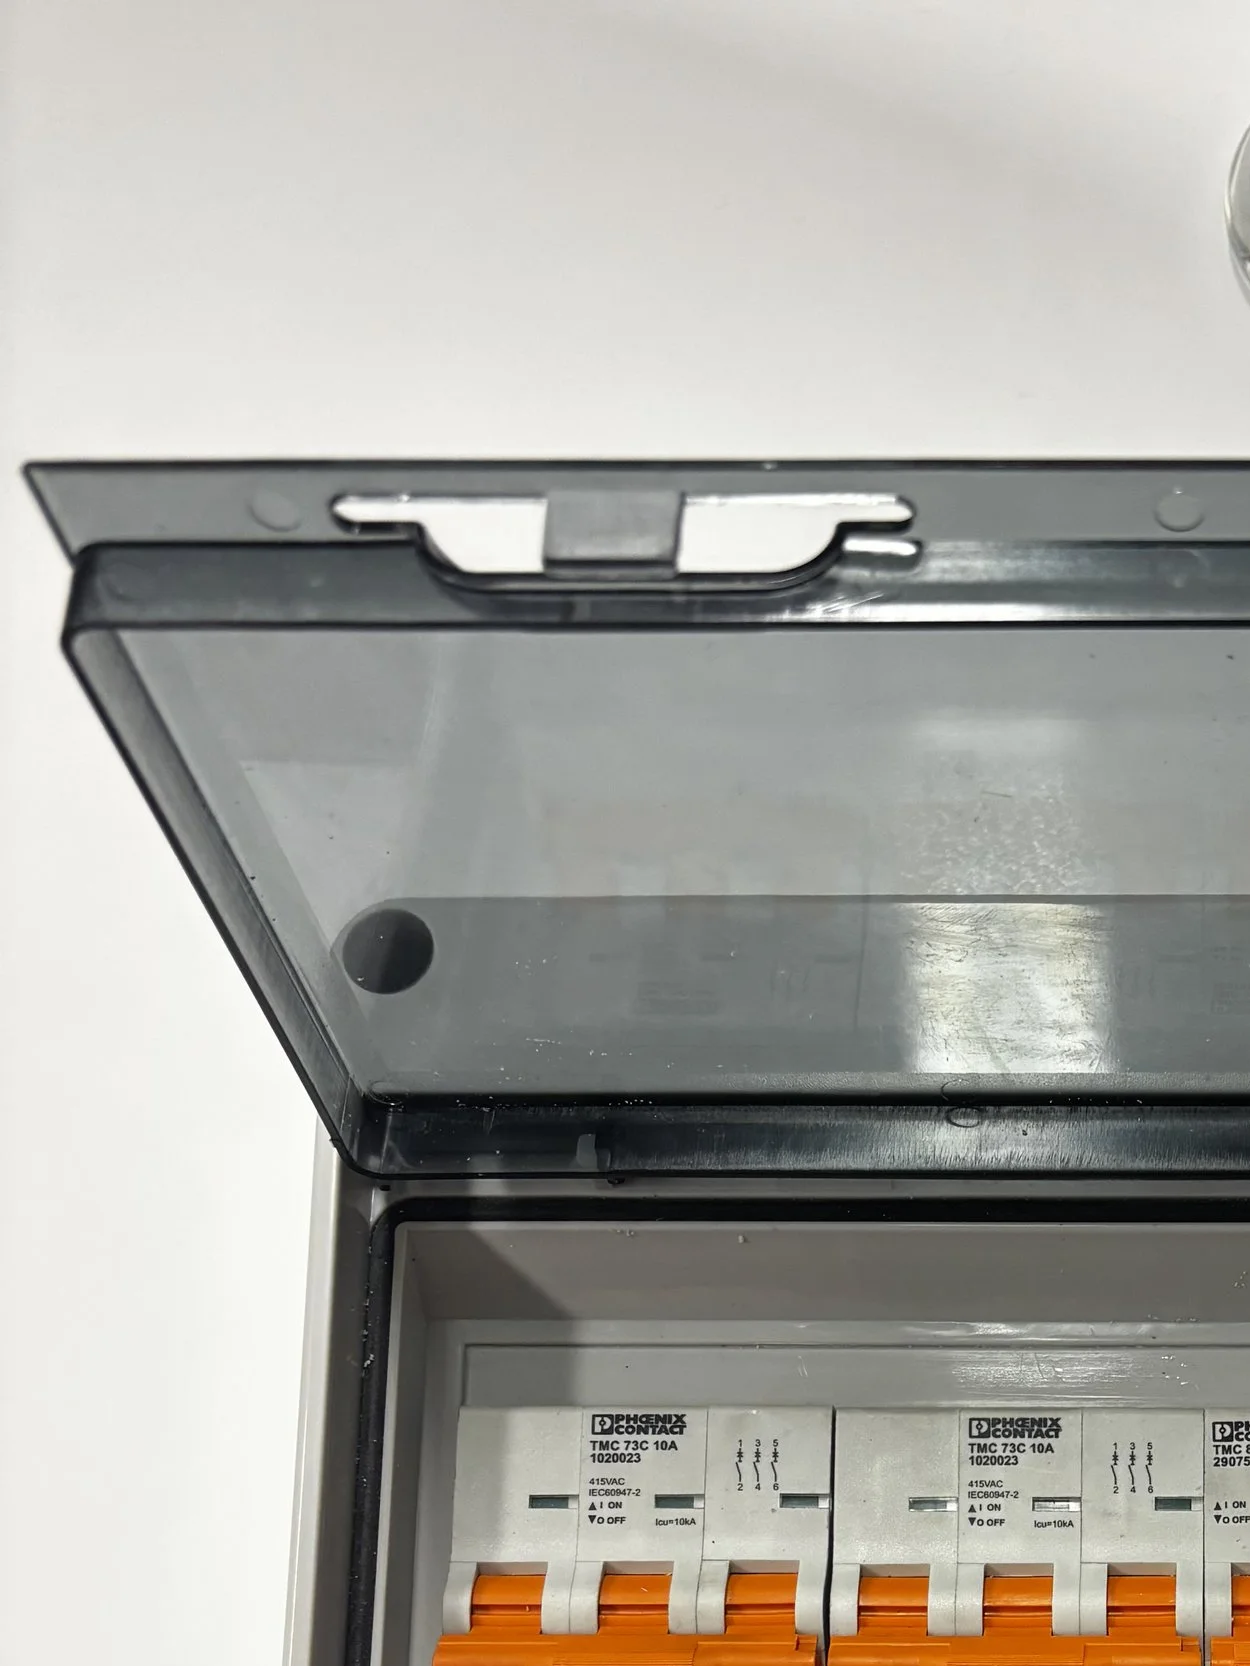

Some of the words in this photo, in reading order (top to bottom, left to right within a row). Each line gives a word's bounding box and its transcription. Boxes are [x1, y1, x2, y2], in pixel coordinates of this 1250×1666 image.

[614, 1425, 687, 1435] CONTACT
[991, 1428, 1062, 1439] CONTACT
[590, 1440, 620, 1451] TMC
[624, 1440, 649, 1451] 73C
[653, 1440, 678, 1451] 10A
[755, 1439, 761, 1447] 3
[773, 1439, 779, 1447] 5
[968, 1443, 997, 1454] TMC
[1001, 1443, 1026, 1454] 73C
[1030, 1443, 1054, 1454] 10A
[1213, 1444, 1242, 1455] TMC
[590, 1453, 641, 1464] 1020023
[969, 1455, 1019, 1466] 1020023
[589, 1477, 625, 1486] 415VAC
[968, 1479, 1003, 1488] 415VAC
[737, 1483, 744, 1491] 2
[755, 1483, 761, 1491] 4
[773, 1483, 779, 1491] 6
[1113, 1486, 1119, 1494] 2
[1130, 1486, 1136, 1494] 4
[1148, 1486, 1154, 1494] 6
[589, 1488, 641, 1497] IEC60947-2
[968, 1490, 1019, 1499] IEC60947-2
[608, 1501, 622, 1509] ON
[987, 1503, 1001, 1512] ON
[1232, 1501, 1246, 1509] ON
[606, 1516, 626, 1525] OFF
[986, 1518, 1005, 1527] OFF
[1232, 1515, 1250, 1524] OFF
